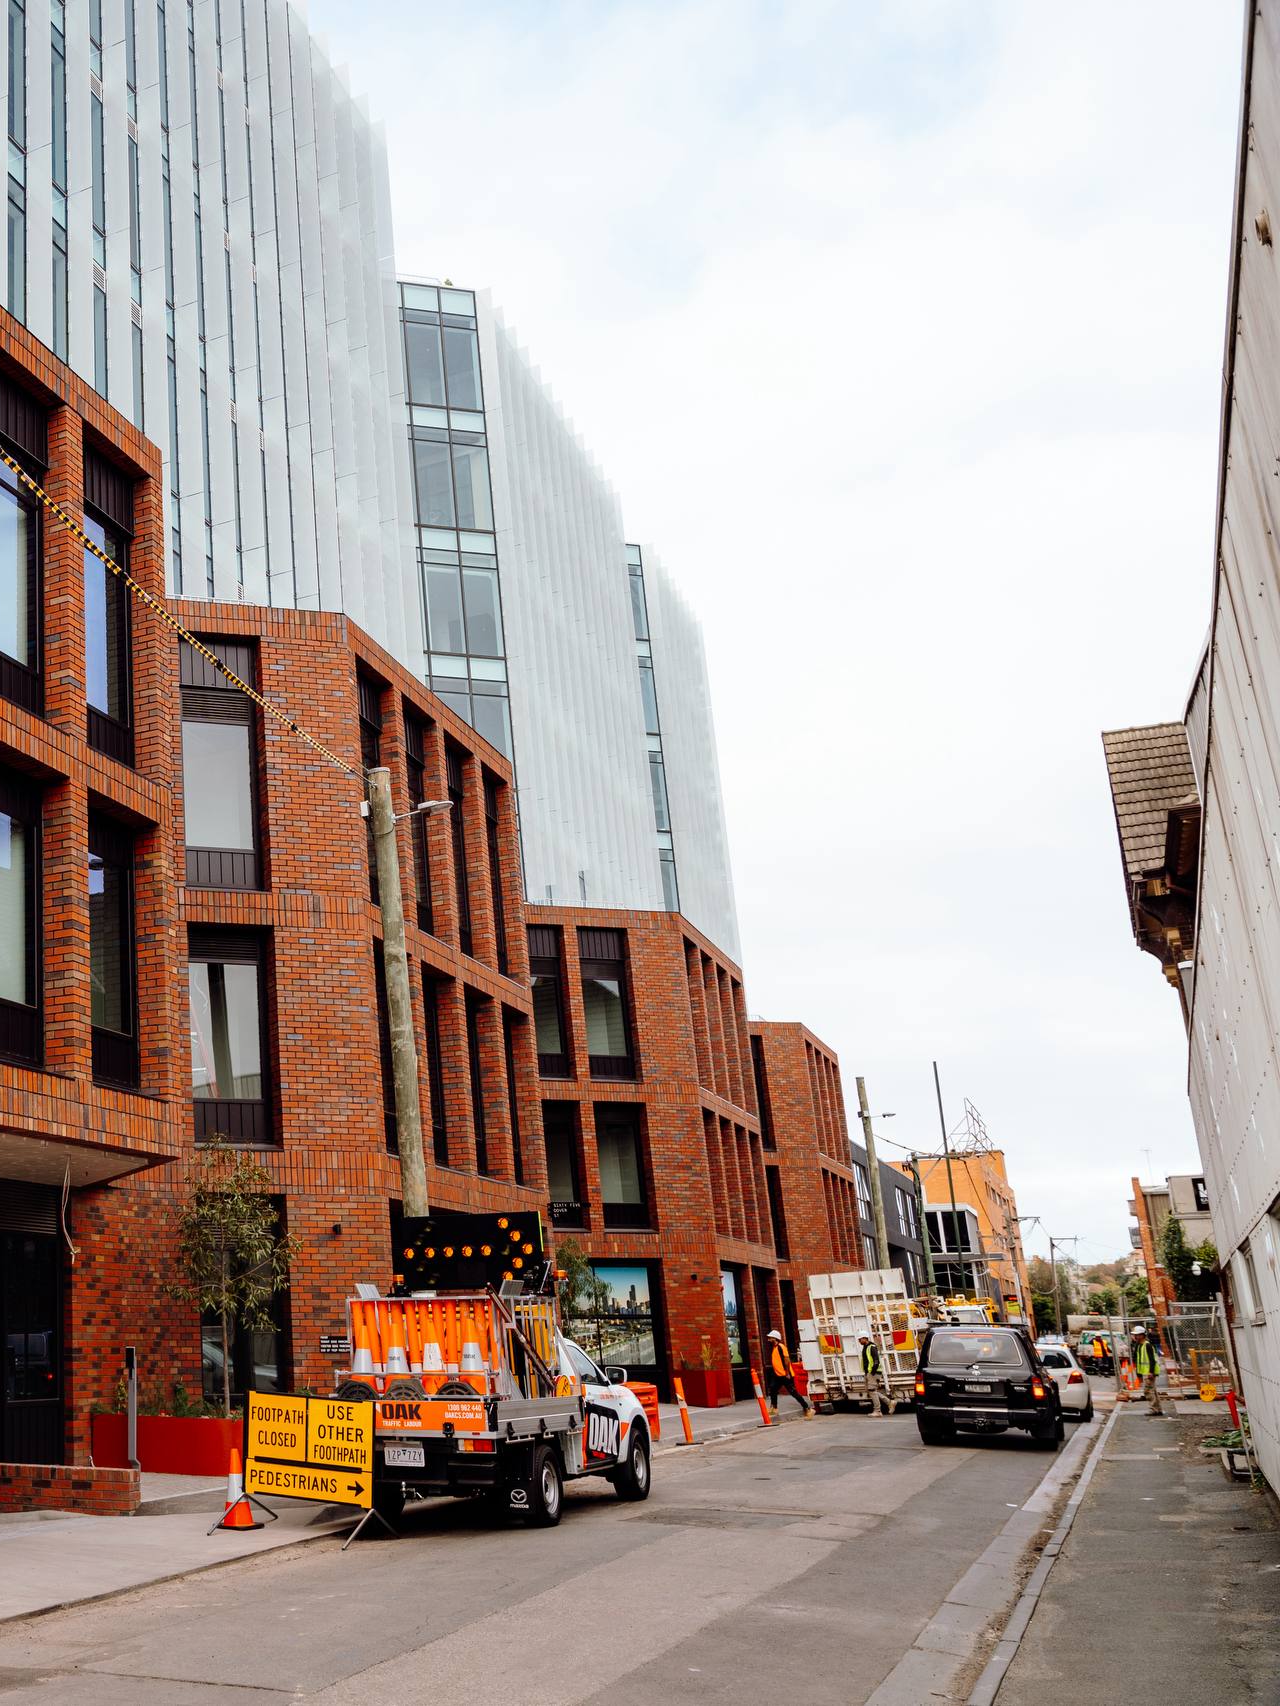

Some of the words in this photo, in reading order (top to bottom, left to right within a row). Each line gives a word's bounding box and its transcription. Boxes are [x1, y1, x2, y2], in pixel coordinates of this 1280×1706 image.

[251, 1406, 304, 1425] FOOTPATH
[327, 1405, 354, 1421] USE
[381, 1403, 422, 1419] OAK
[258, 1430, 297, 1448] CLOSED
[318, 1424, 364, 1443] OTHER
[589, 1412, 618, 1455] OAK
[314, 1444, 367, 1464] FOOTHPATH
[250, 1469, 337, 1493] PEDESTRIANS
